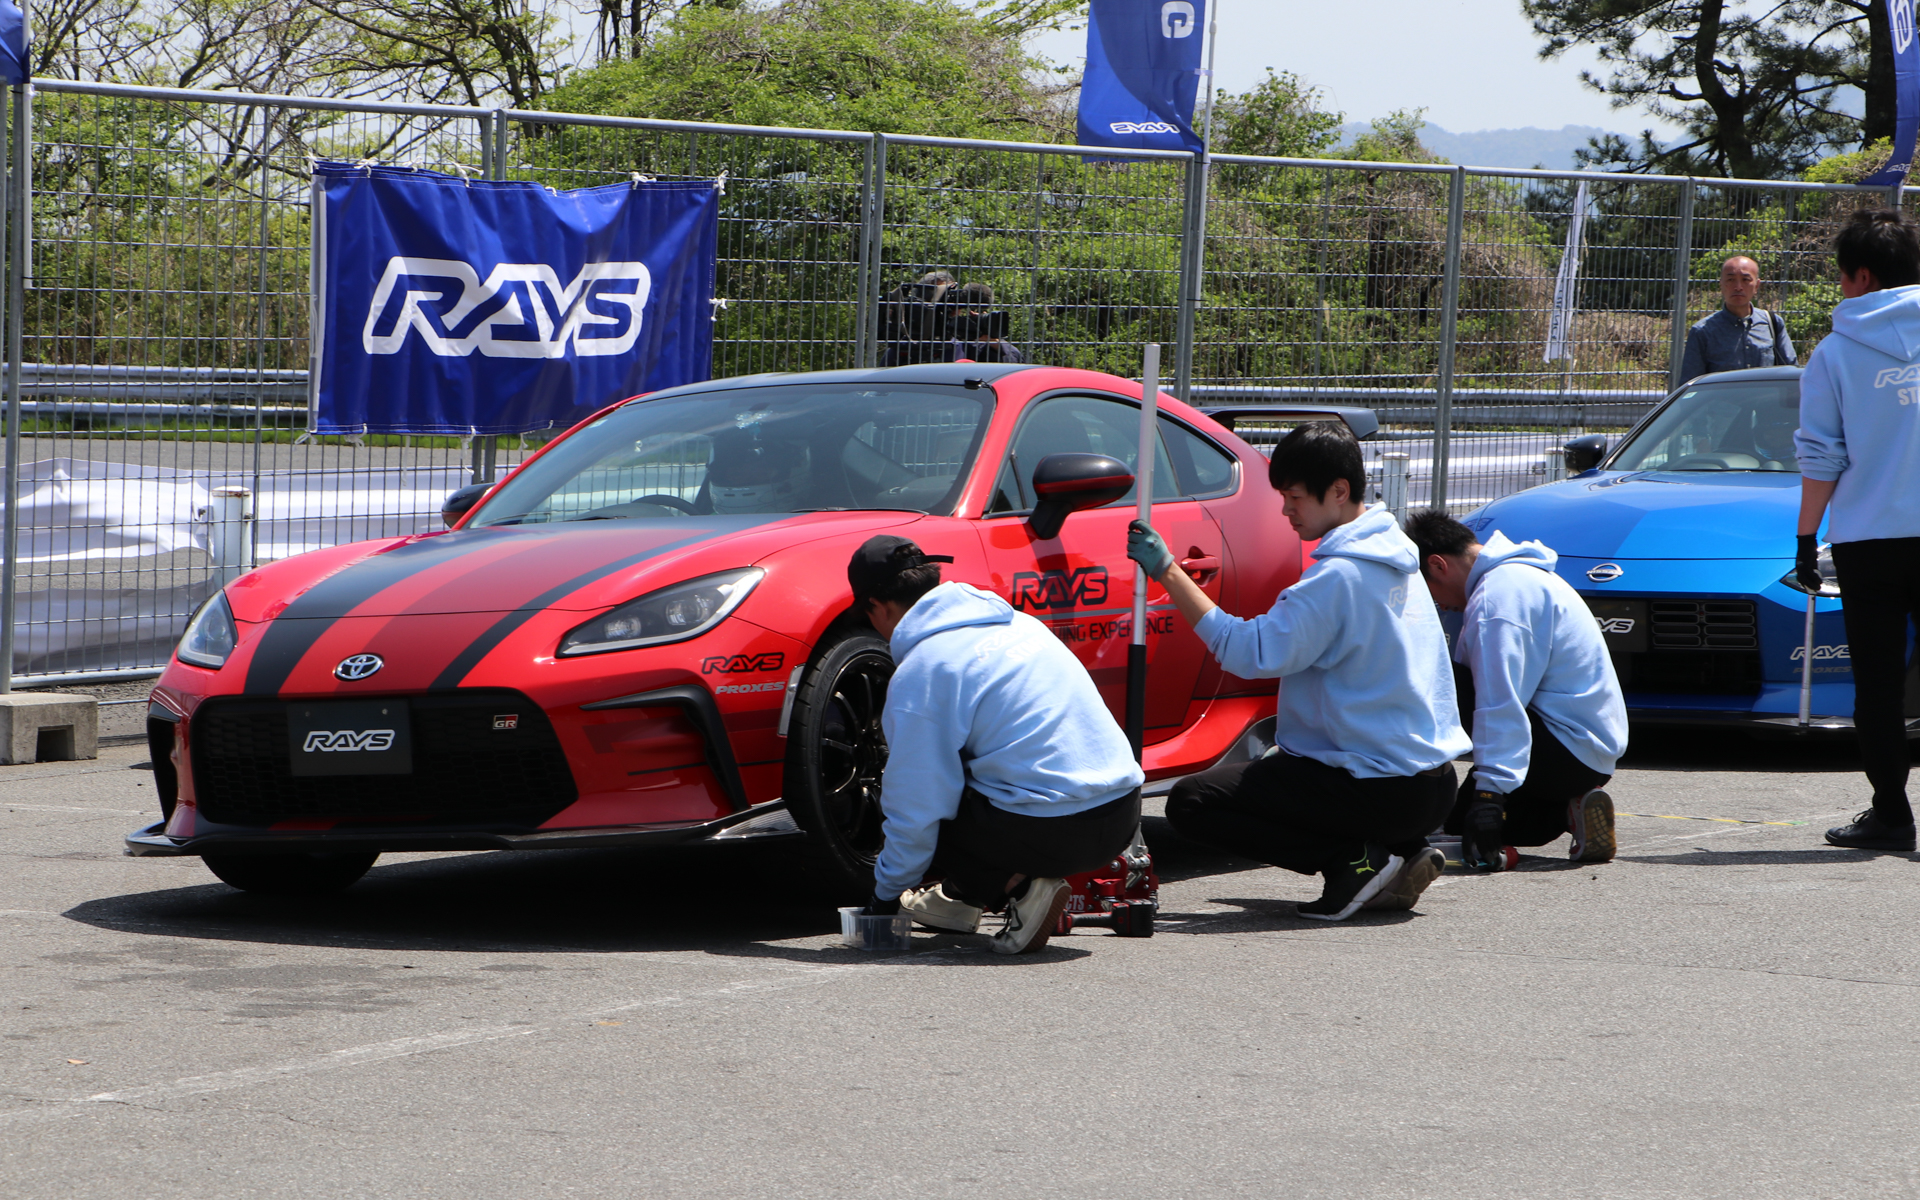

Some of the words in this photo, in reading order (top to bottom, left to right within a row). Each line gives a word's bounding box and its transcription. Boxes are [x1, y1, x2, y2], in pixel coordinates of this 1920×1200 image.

[363, 256, 651, 358] RAYS
[1012, 565, 1109, 611] RAYS
[1050, 624, 1086, 642] VING
[1090, 616, 1174, 640] EXPERNCE
[1594, 616, 1635, 634] YS
[701, 652, 785, 674] RAYS
[1792, 665, 1852, 674] POXES
[715, 681, 785, 694] PROXES
[493, 718, 517, 728] GR
[303, 729, 395, 752] RAYS
[1065, 894, 1085, 911] CTS
